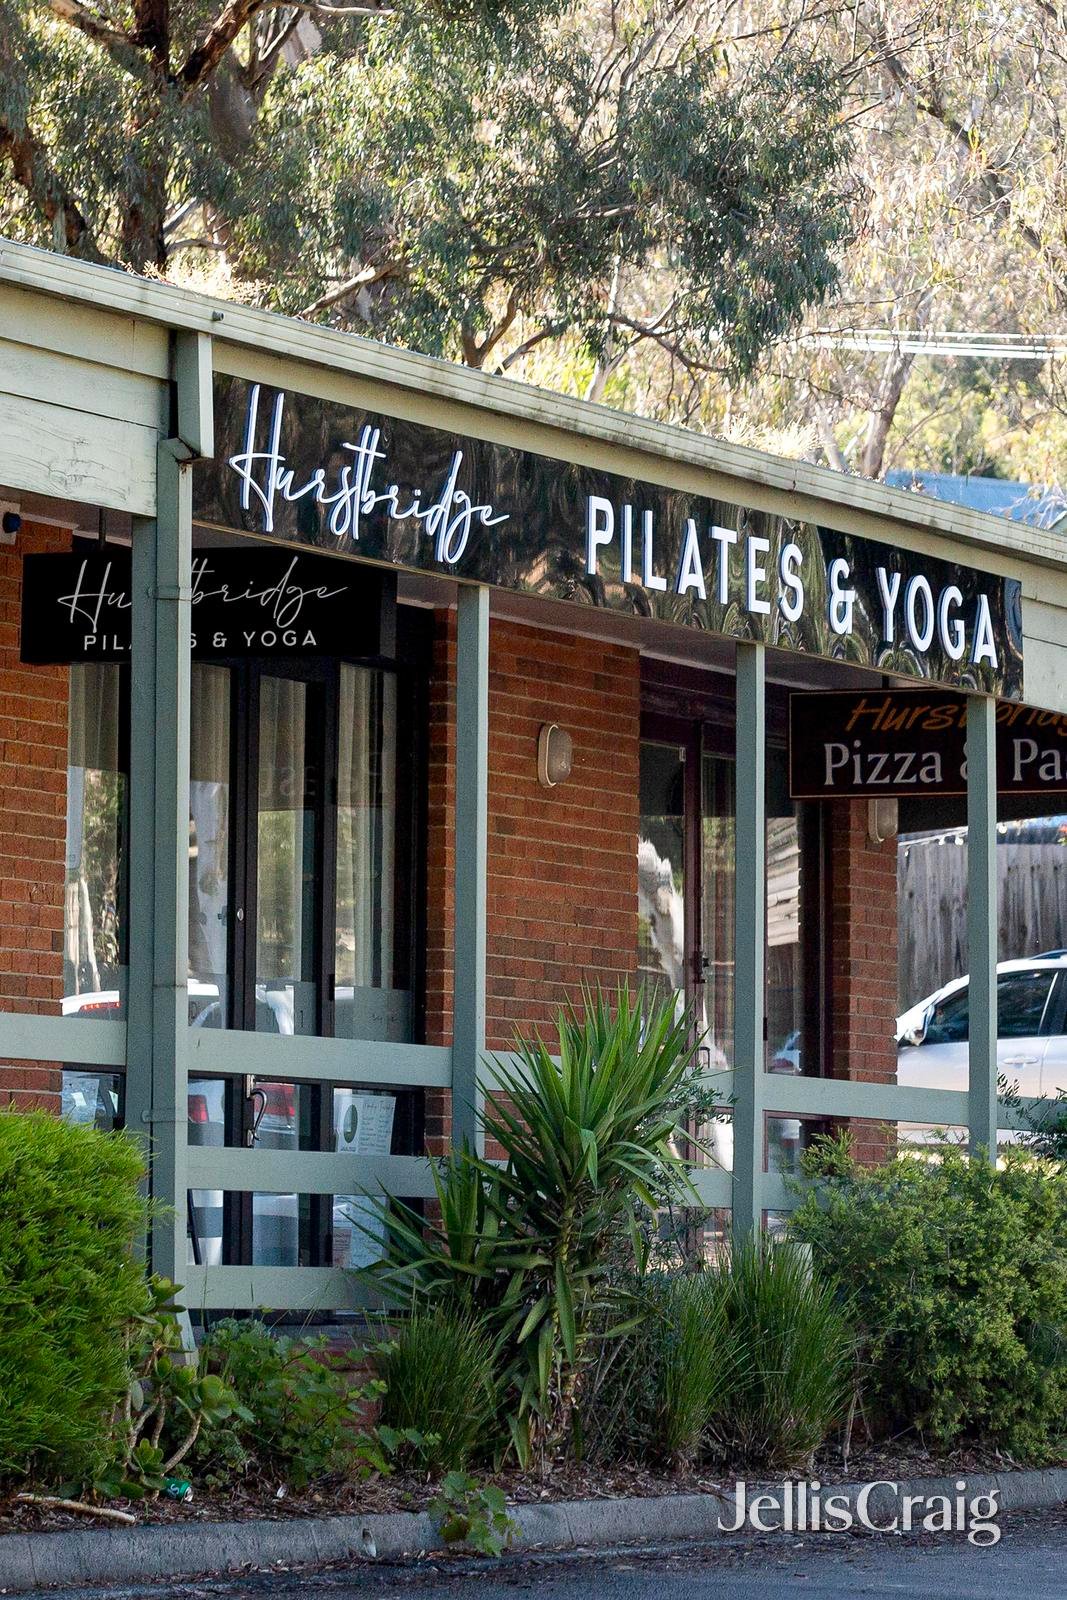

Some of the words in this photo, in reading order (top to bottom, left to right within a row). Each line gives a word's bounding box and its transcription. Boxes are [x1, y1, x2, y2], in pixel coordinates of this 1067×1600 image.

[229, 384, 510, 564] Hurstbridge
[585, 495, 804, 622] PILATES
[828, 557, 856, 635] &
[875, 566, 999, 669] YOGA
[84, 631, 197, 650] PILS
[212, 631, 228, 648] &
[243, 629, 317, 647] YOGA
[823, 739, 943, 786] Pizza
[1012, 738, 1067, 782] Pa
